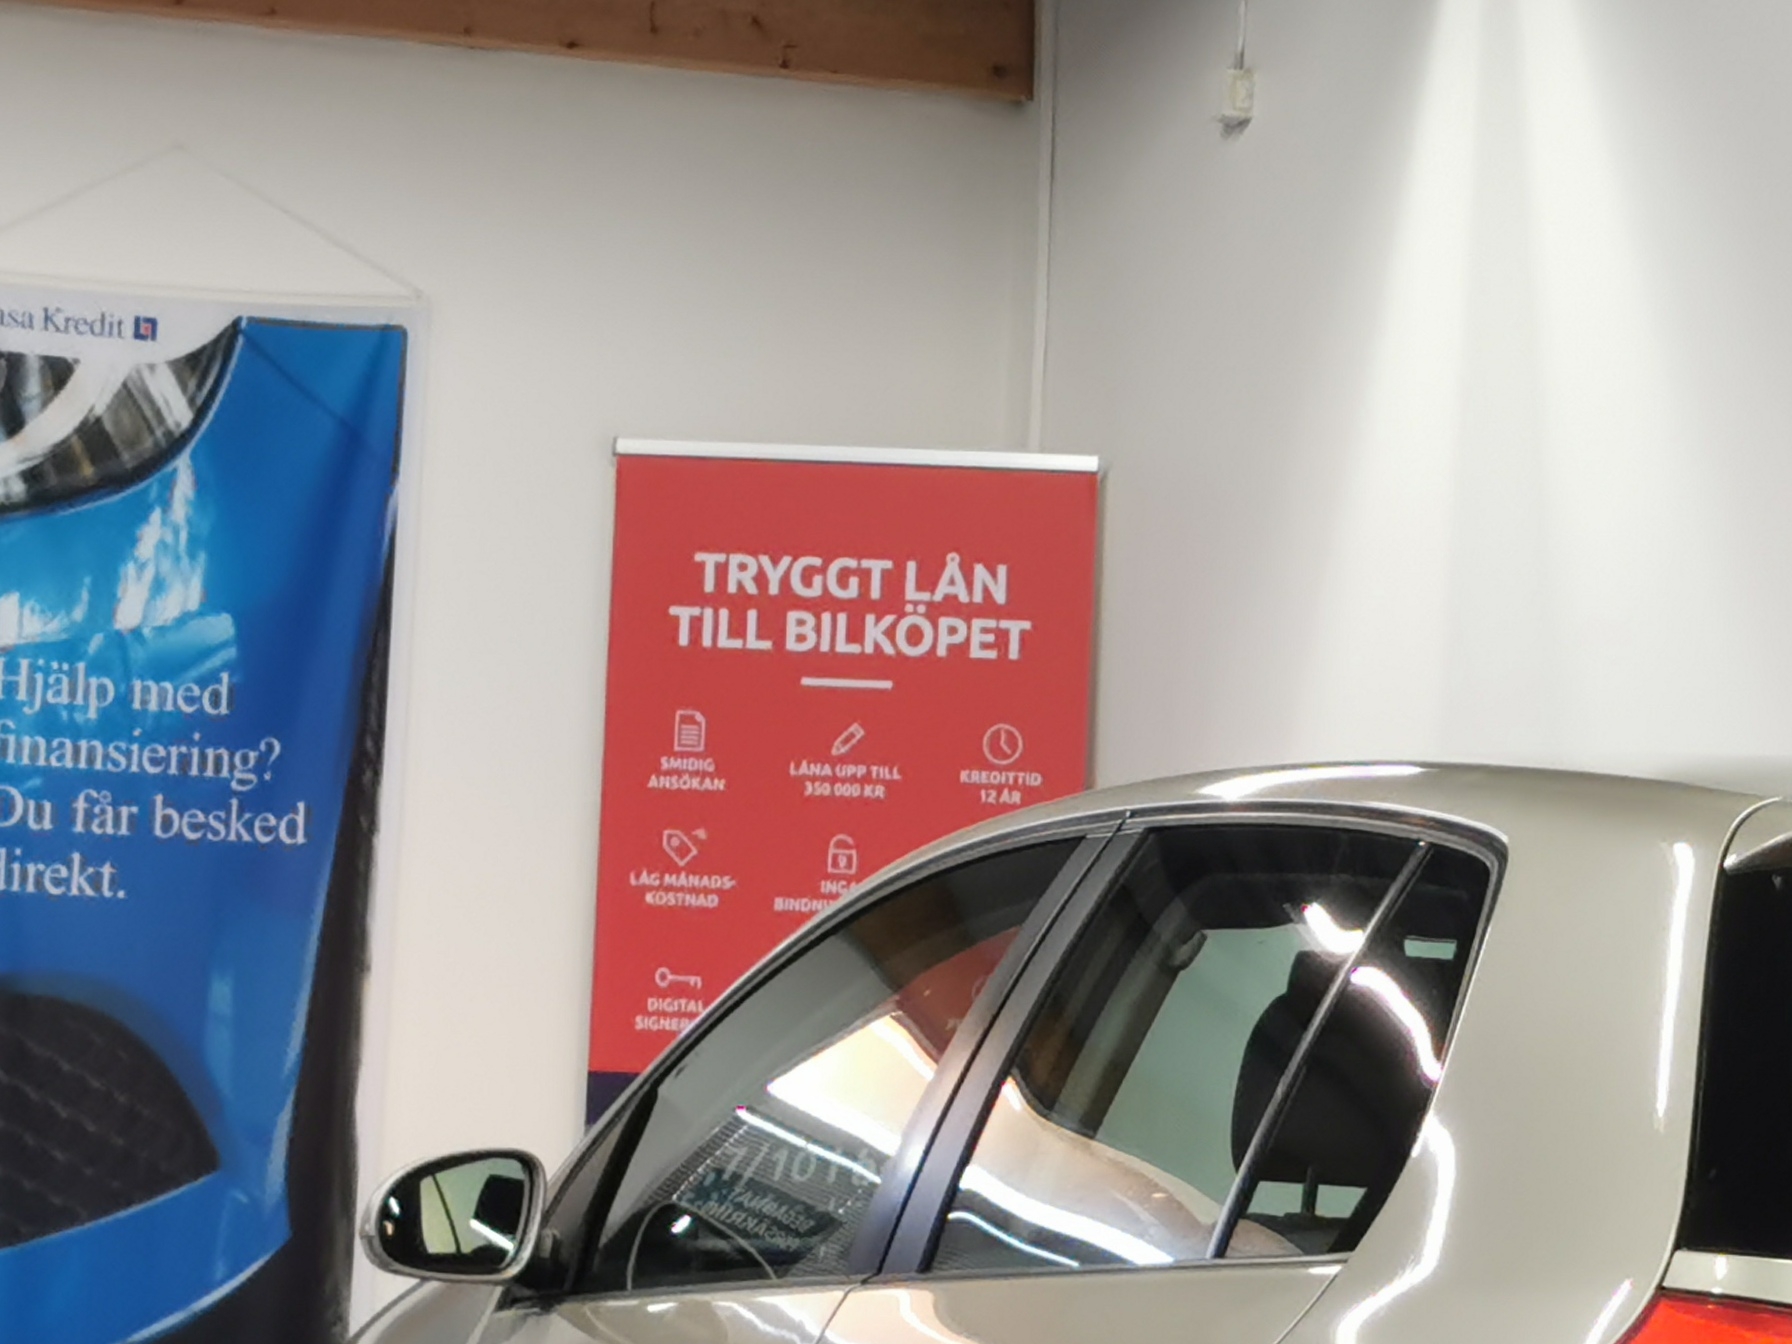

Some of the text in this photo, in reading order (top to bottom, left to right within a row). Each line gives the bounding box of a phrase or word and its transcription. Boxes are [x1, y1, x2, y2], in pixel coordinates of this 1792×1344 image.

[42, 306, 125, 339] Kredit
[694, 551, 1008, 605] TRYGGT LÅN
[668, 603, 1032, 660] TILL BILKÖPET
[0, 656, 230, 720] Hjälp med
[660, 756, 715, 773] SMIDIG
[789, 760, 902, 780] LÅNA UPP TILL
[647, 773, 726, 791] ANSÖKAN
[960, 770, 1043, 787] KREDITTID
[804, 781, 886, 799] 350 000 KR
[980, 789, 1022, 805] 12 ÅR
[0, 783, 307, 845] Du får besked
[0, 847, 126, 899] irekt.
[629, 869, 737, 889] LÅG MÅNADS-
[821, 879, 857, 895] ING
[645, 891, 720, 909] KOSTNAD
[774, 897, 833, 913] BINDN
[647, 997, 705, 1014] DIGITAL
[635, 1014, 691, 1033] SIGNER
